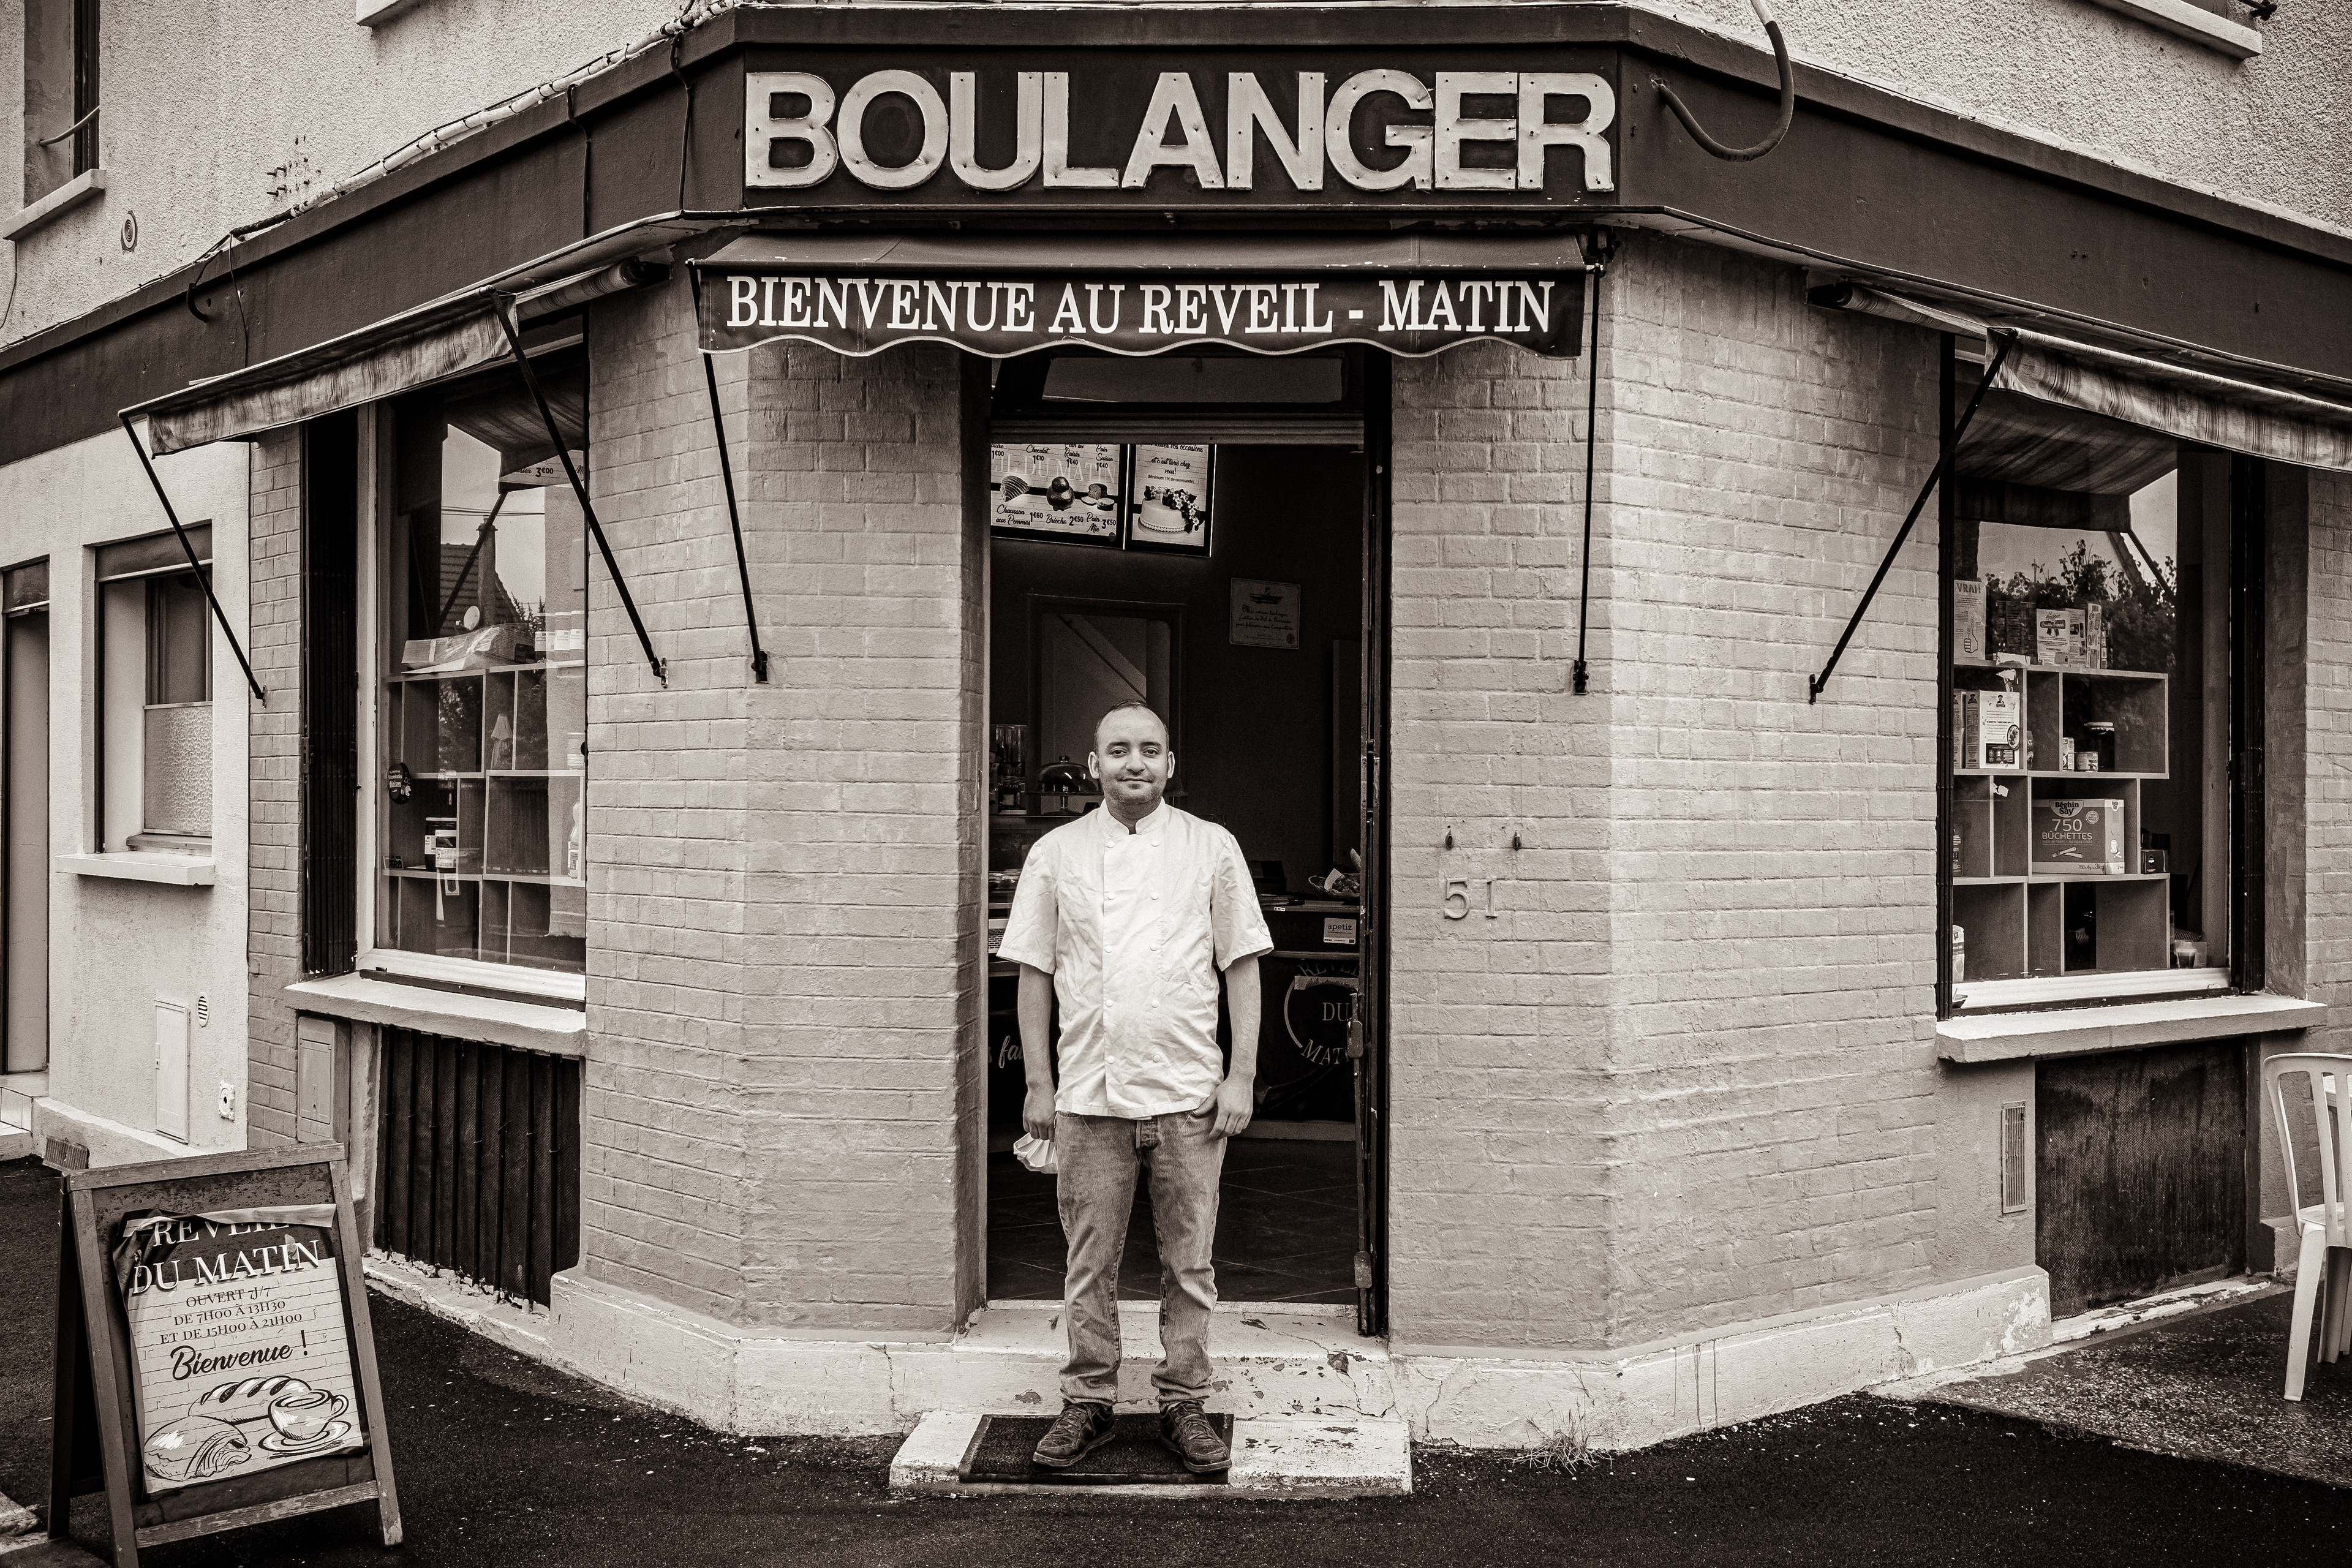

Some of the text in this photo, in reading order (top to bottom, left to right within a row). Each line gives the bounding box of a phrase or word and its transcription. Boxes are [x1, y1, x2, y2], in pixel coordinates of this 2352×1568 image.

[745, 69, 1616, 193] BOULANGER
[726, 276, 1035, 334] BIENVENUE
[1049, 284, 1125, 336] AU
[1140, 282, 1334, 336] REVEIL
[1378, 280, 1555, 334] MATIN
[1026, 444, 1051, 453] Chocolat
[1065, 447, 1080, 459] Raisin
[1096, 443, 1107, 452] Pain
[992, 450, 1005, 459] 1€00
[1033, 455, 1044, 464] 1€10
[1096, 453, 1113, 461] Suisse
[1066, 459, 1078, 468] 1€40
[1096, 462, 1108, 472] 1€40
[1180, 461, 1191, 470] chez
[535, 467, 554, 478] 3€00
[997, 504, 1025, 514] Chausson
[1008, 514, 1030, 526] Pommes
[1030, 512, 1043, 522] 1€60
[1046, 514, 1067, 525] Brioche
[1069, 516, 1084, 526] 2€50
[1086, 512, 1100, 522] Pain
[1086, 522, 1100, 533] Mie
[1101, 519, 1117, 529] 3€50
[2059, 807, 2075, 816] Say
[2052, 818, 2082, 832] 750
[2042, 831, 2093, 840] BÛCHETTES
[1444, 877, 1498, 921] 51
[1322, 1002, 1350, 1022] DU
[1300, 1039, 1351, 1065] MATI
[132, 1240, 320, 1294] DU MATIN
[186, 1286, 271, 1308] OUVERT 7J/7
[175, 1314, 194, 1325] DE
[235, 1303, 245, 1316] À
[248, 1300, 286, 1314] 13H30
[160, 1313, 303, 1344] ET DE 15H00 À 21H00
[170, 1344, 293, 1381] Bienvenue
